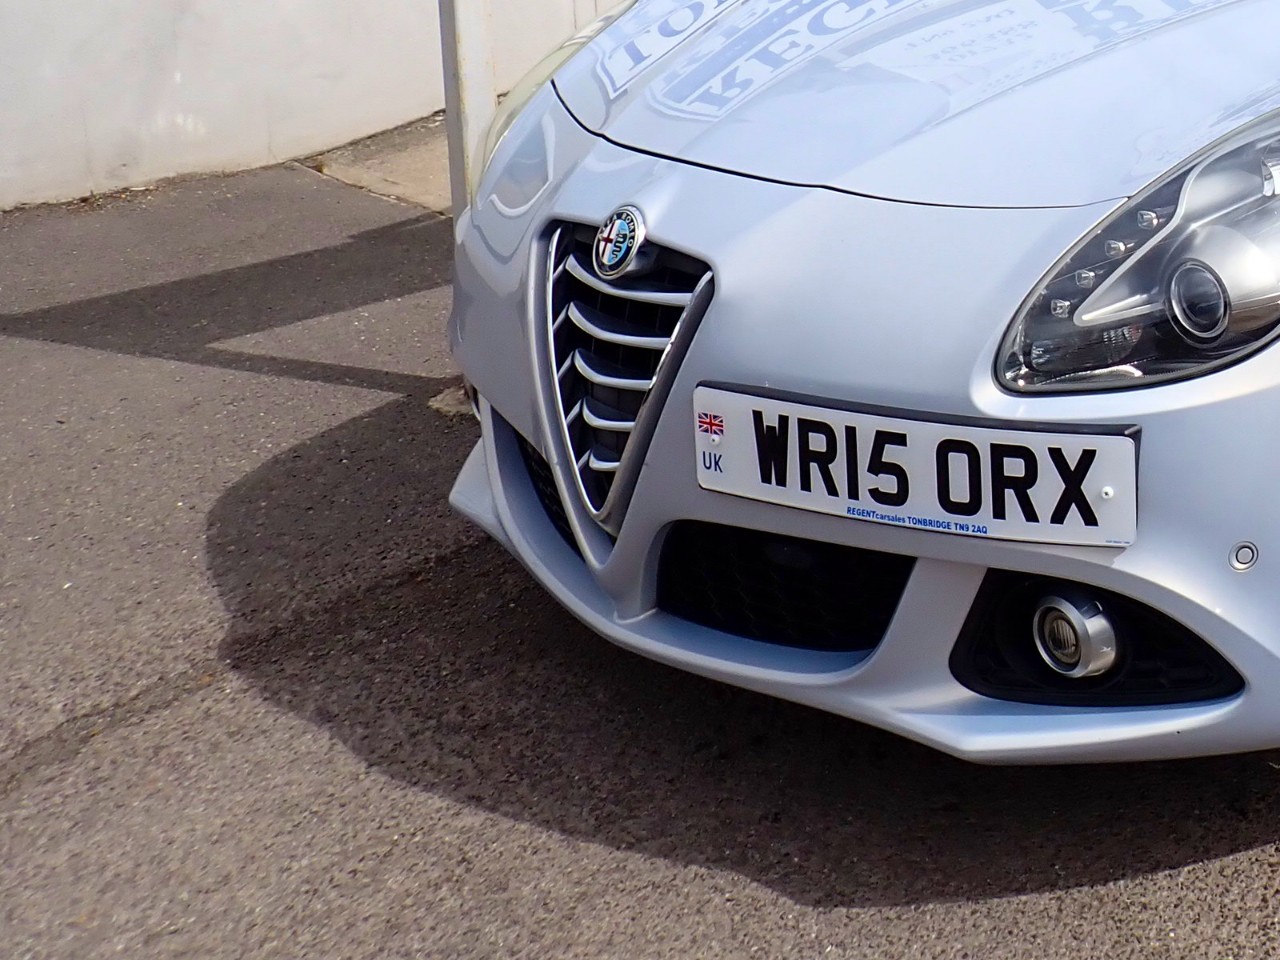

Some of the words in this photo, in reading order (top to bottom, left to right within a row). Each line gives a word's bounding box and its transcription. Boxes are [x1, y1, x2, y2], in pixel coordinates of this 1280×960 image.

[702, 450, 723, 473] UK
[751, 409, 910, 507] WR15
[935, 438, 1099, 527] ORX
[846, 506, 906, 524] REGENTcarsales
[907, 516, 952, 530] TONBRIDGE
[954, 522, 970, 532] TN9
[971, 524, 988, 535] 2AQ
